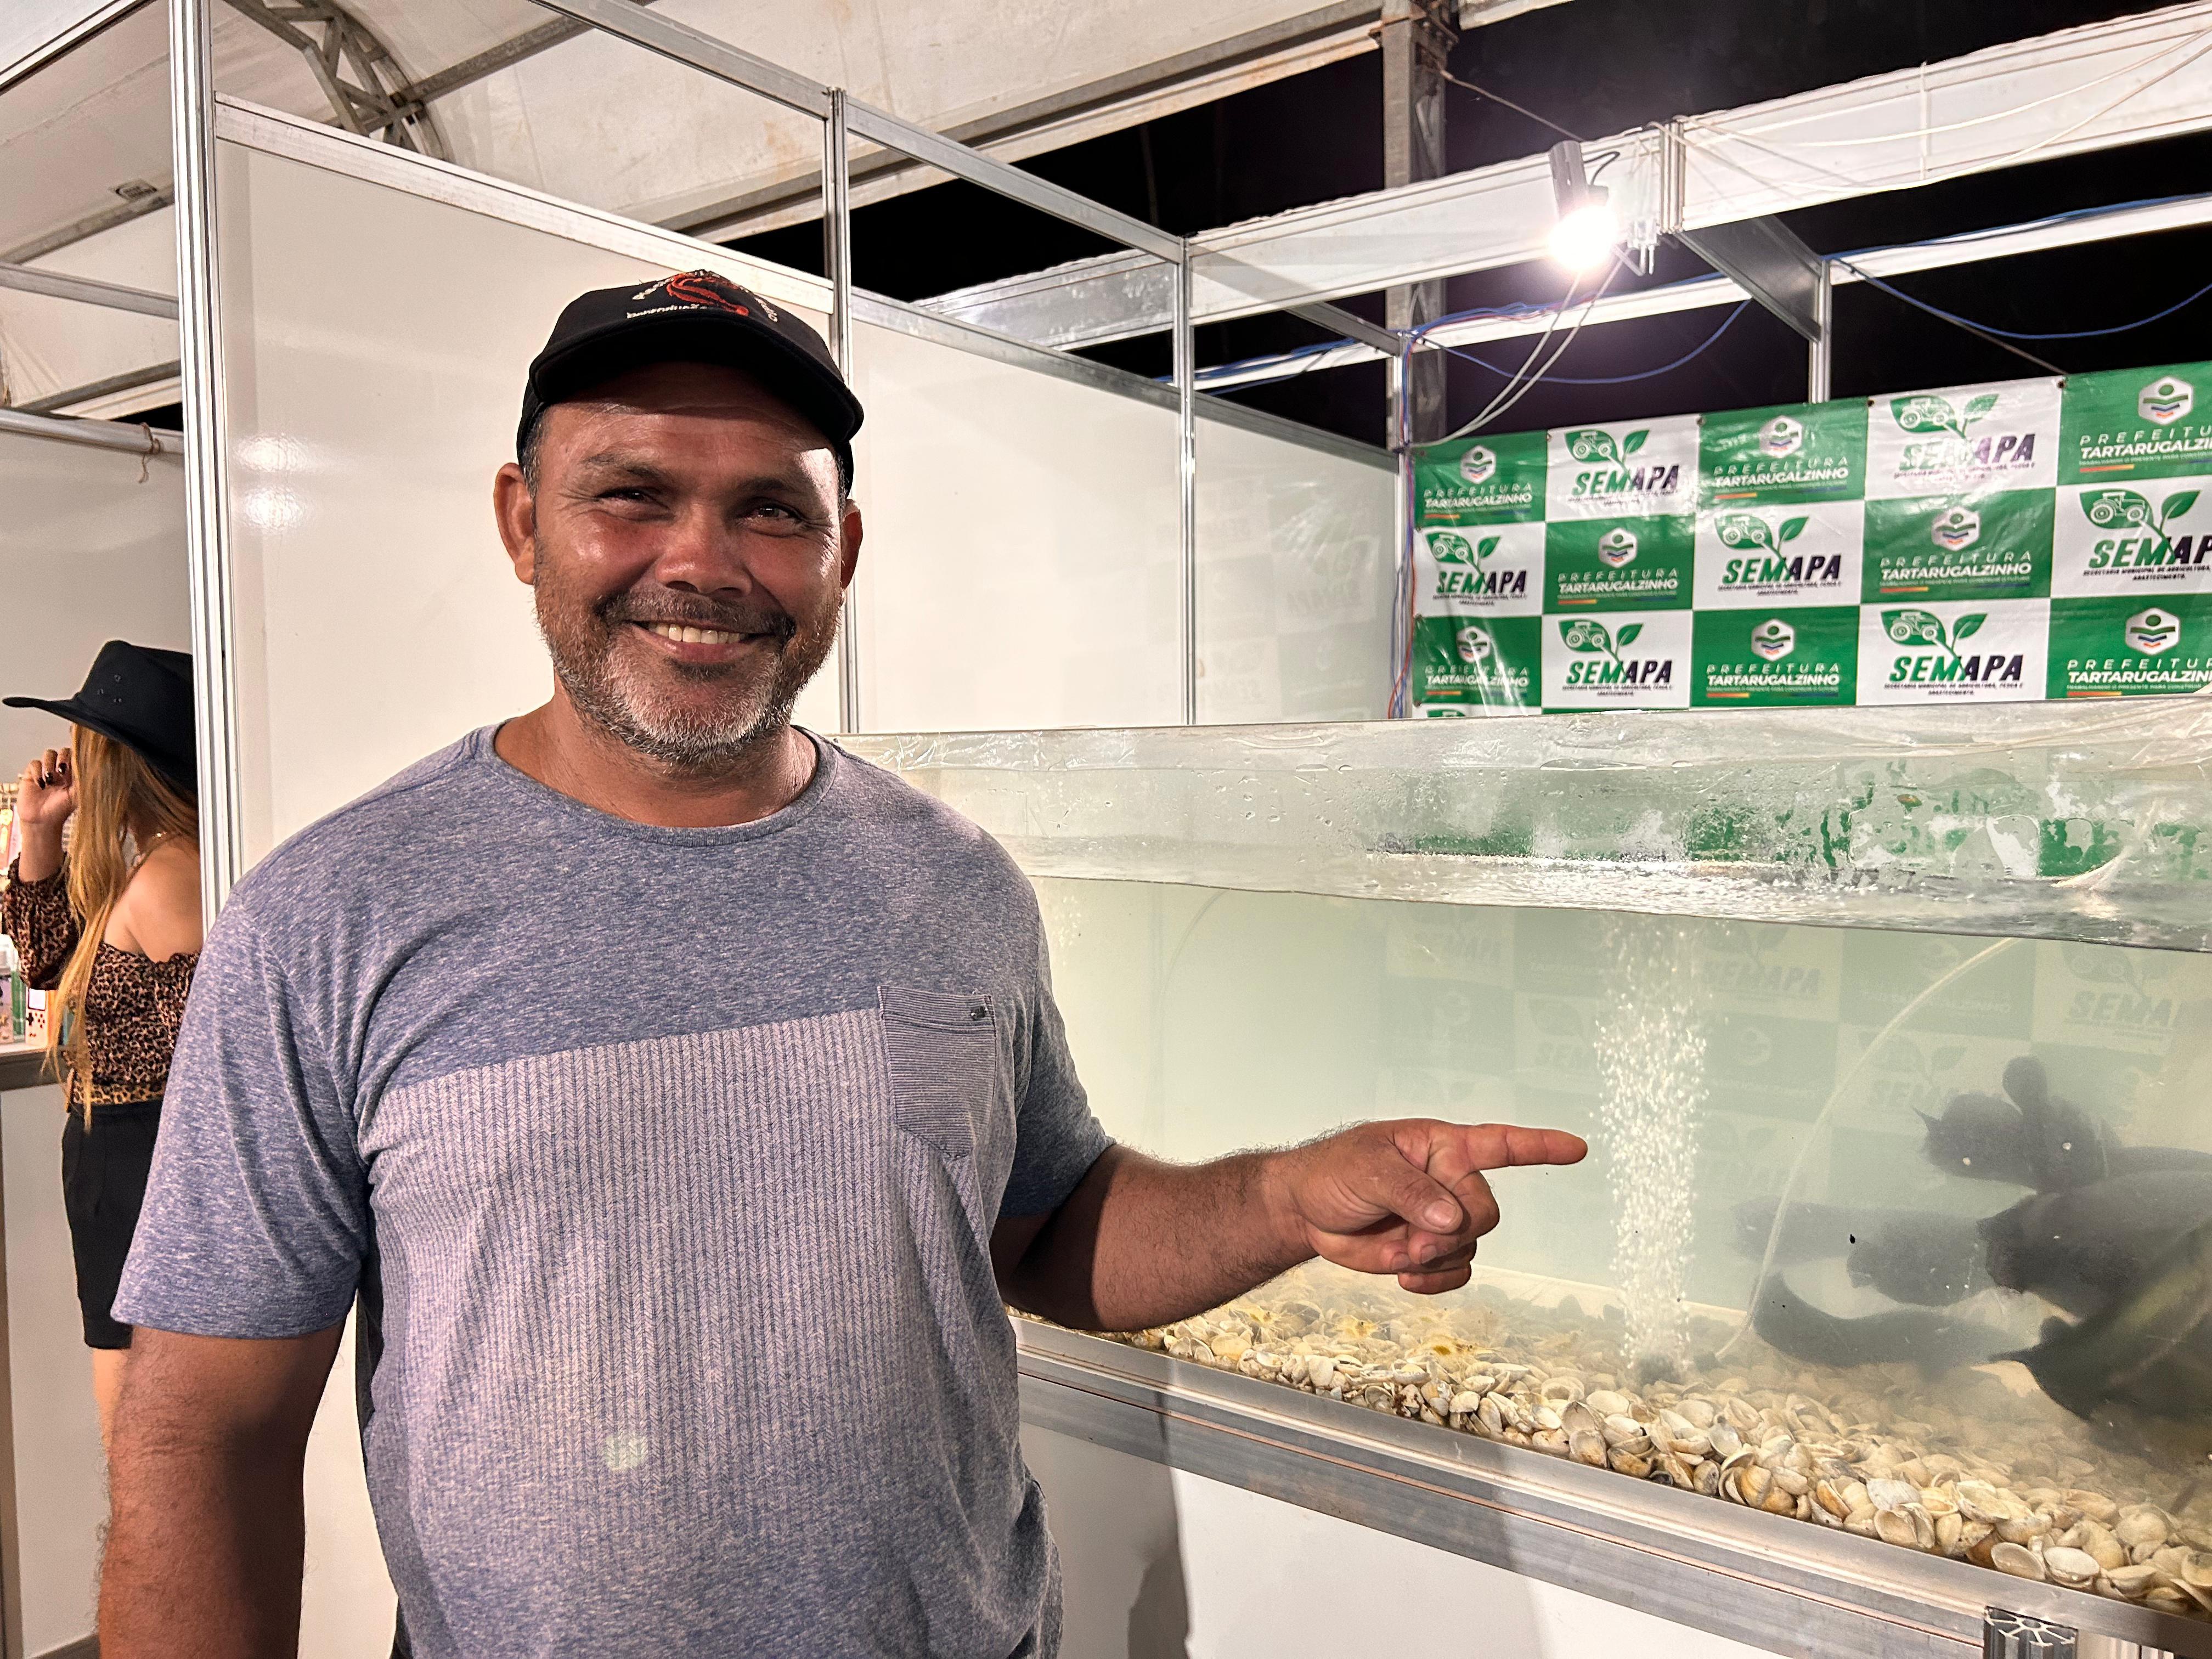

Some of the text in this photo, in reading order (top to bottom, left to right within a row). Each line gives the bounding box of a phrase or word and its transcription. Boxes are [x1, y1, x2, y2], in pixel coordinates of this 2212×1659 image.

[1714, 456, 1848, 475] PREFEITURA
[1571, 465, 1679, 495] SEMAPA
[1715, 467, 1849, 487] TARTARUGALZINHO
[1424, 483, 1532, 498] PREFEITURA
[1425, 492, 1533, 509] TARTARUGALZINHO
[1880, 551, 2030, 568] PREFEITURA
[1558, 567, 1678, 582] PREFEITURA
[1722, 555, 1841, 584] SEMAPA
[1881, 562, 2032, 580] TARTARUGALZINHO
[1436, 570, 1526, 593] SEMAPA
[1559, 579, 1678, 593] TARTARUGALZINHO
[1566, 660, 1672, 684] SEMAPA
[1707, 663, 1838, 674] PREFEITURA
[1889, 655, 2023, 681] SEMAPA
[1707, 673, 1839, 686] TARTARUGALZINHO
